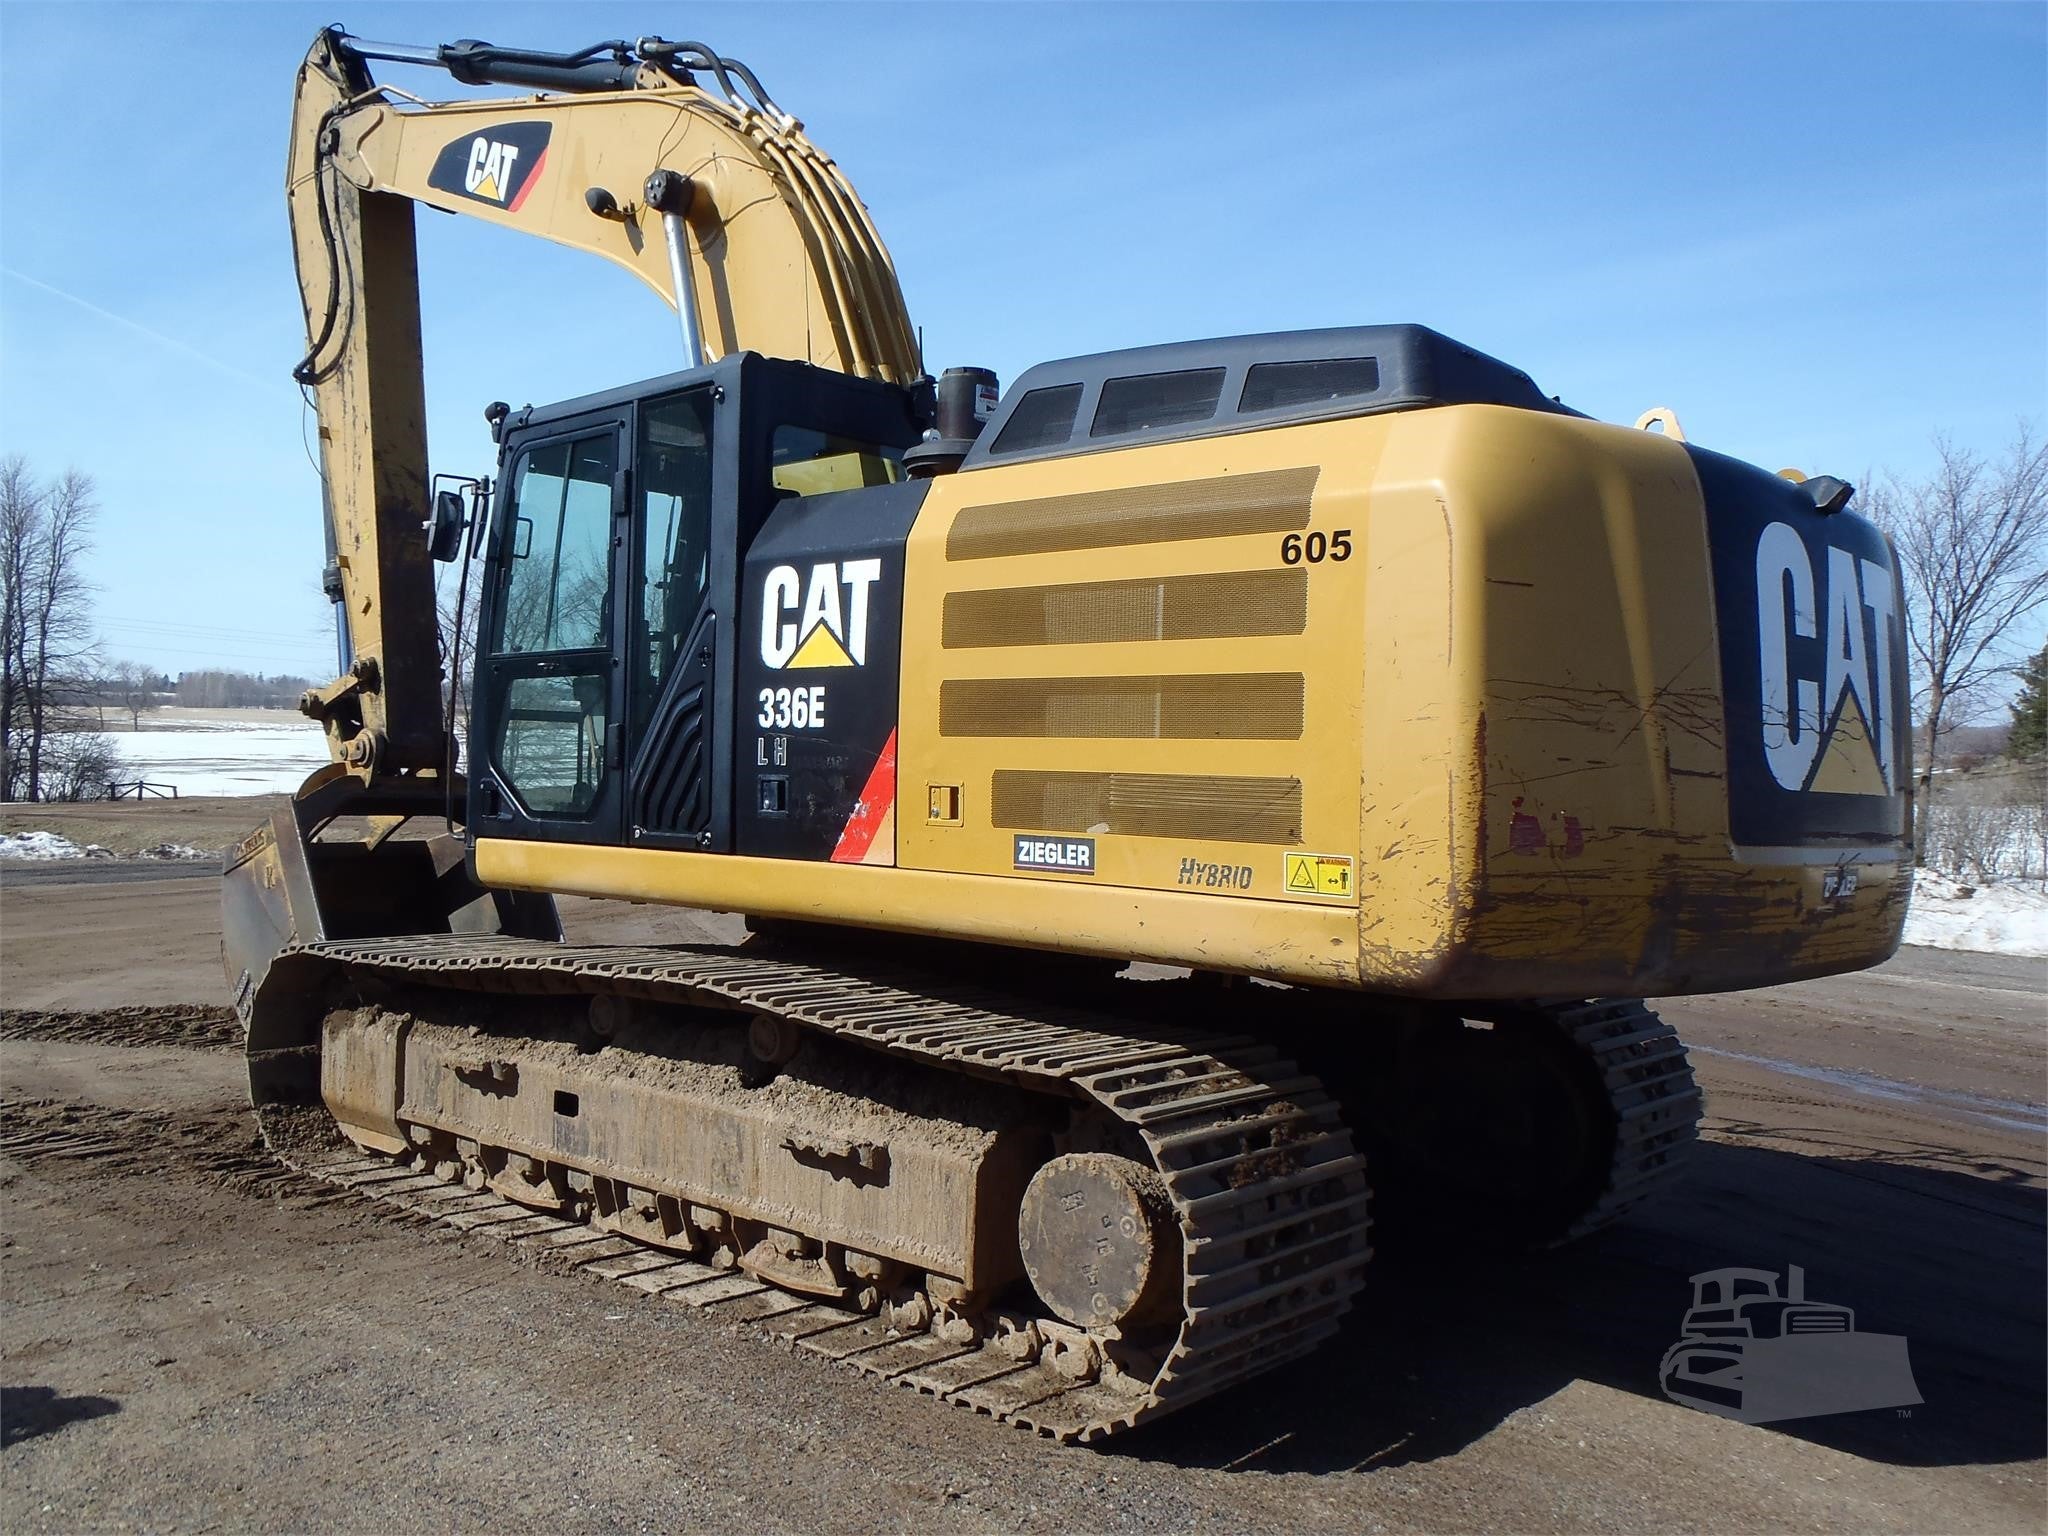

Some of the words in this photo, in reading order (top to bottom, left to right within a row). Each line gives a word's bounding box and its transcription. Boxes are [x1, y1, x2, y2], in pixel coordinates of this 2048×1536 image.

[464, 136, 519, 202] CAT
[1281, 529, 1352, 565] 605
[760, 558, 881, 669] CAT
[1756, 521, 1895, 797] CAT
[758, 686, 825, 729] 336E
[1018, 840, 1090, 867] ZIEGLER
[1178, 857, 1253, 890] HYBRID
